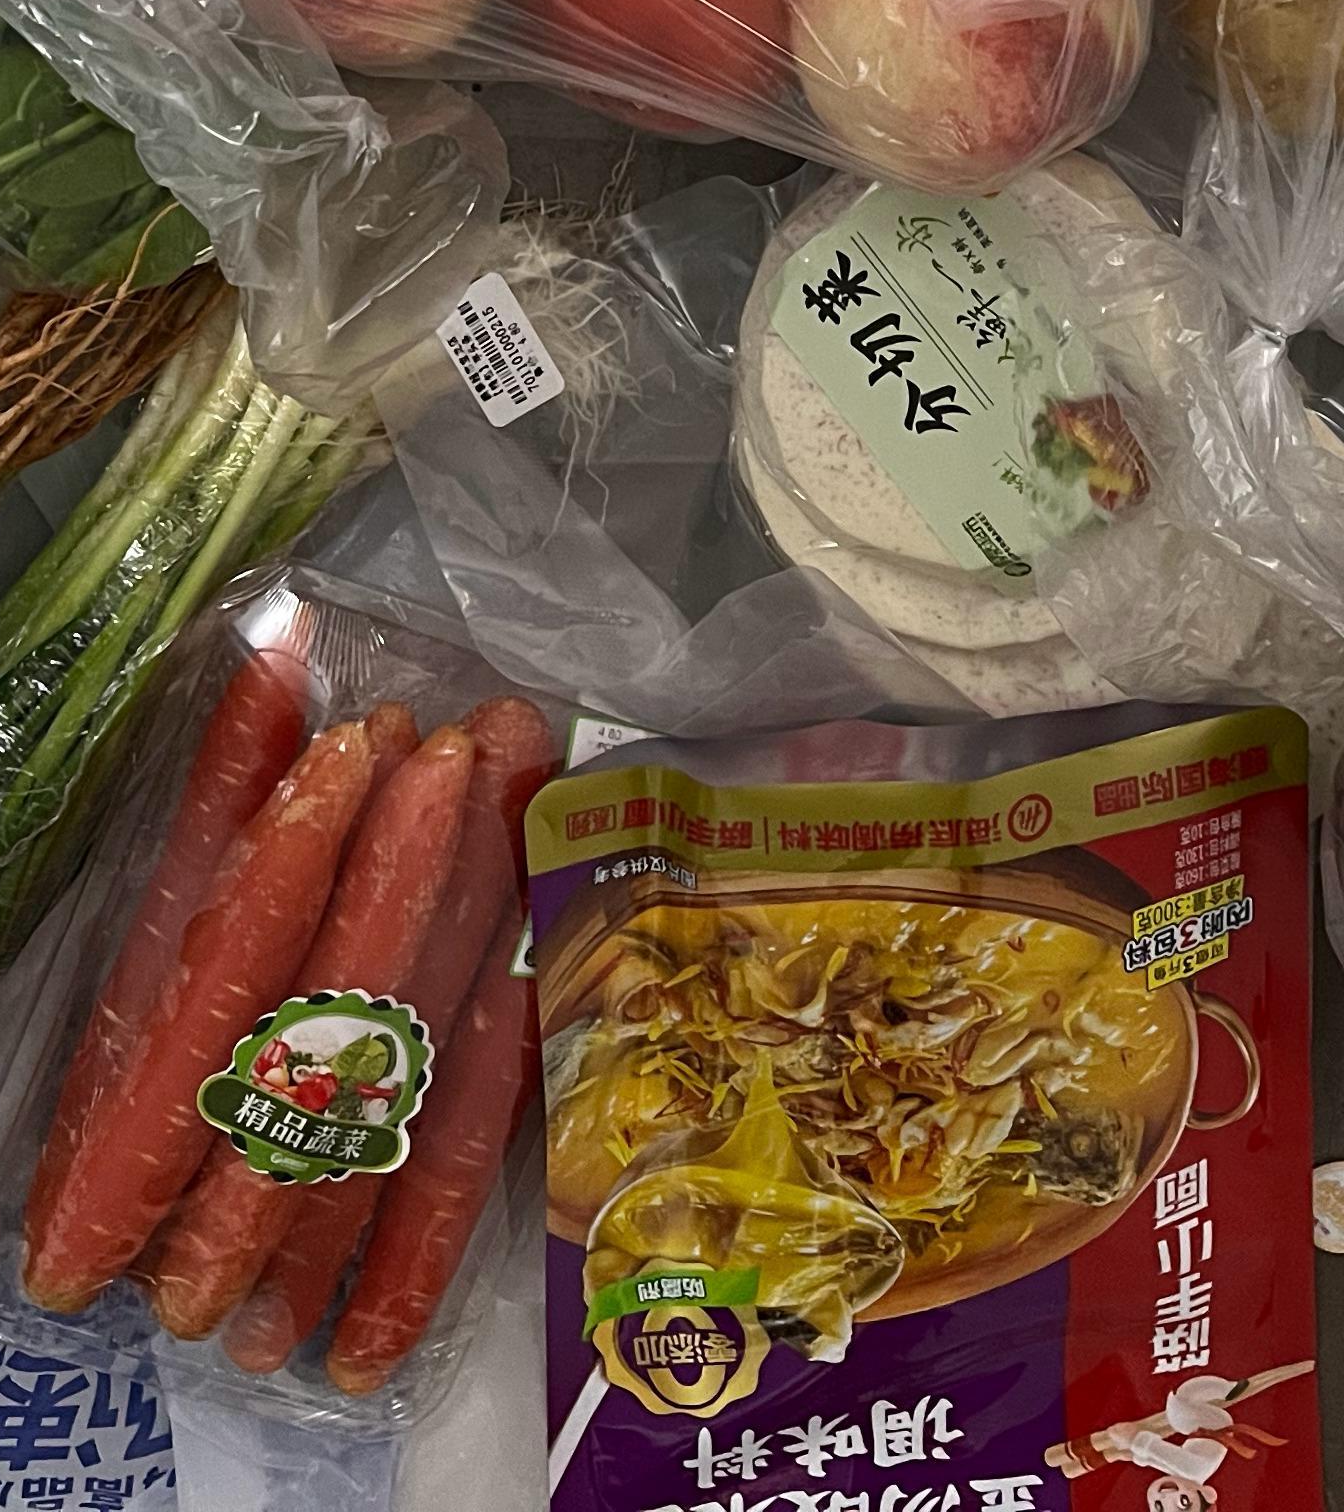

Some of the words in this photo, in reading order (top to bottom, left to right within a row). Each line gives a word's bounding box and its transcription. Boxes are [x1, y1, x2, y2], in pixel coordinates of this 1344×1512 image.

[483, 306, 539, 393] 701101000215
[803, 250, 972, 435] 分切菜
[777, 814, 1001, 851] 海底捞调味料
[1124, 900, 1252, 970] 内附3包料
[1137, 878, 1242, 935] 净含量:300克
[233, 1092, 372, 1160] 精品蔬菜
[638, 1277, 707, 1302] 防腐剂
[1151, 1158, 1212, 1375] 筷手小厨
[633, 1333, 737, 1367] 零添加
[683, 1395, 965, 1488] 调味料
